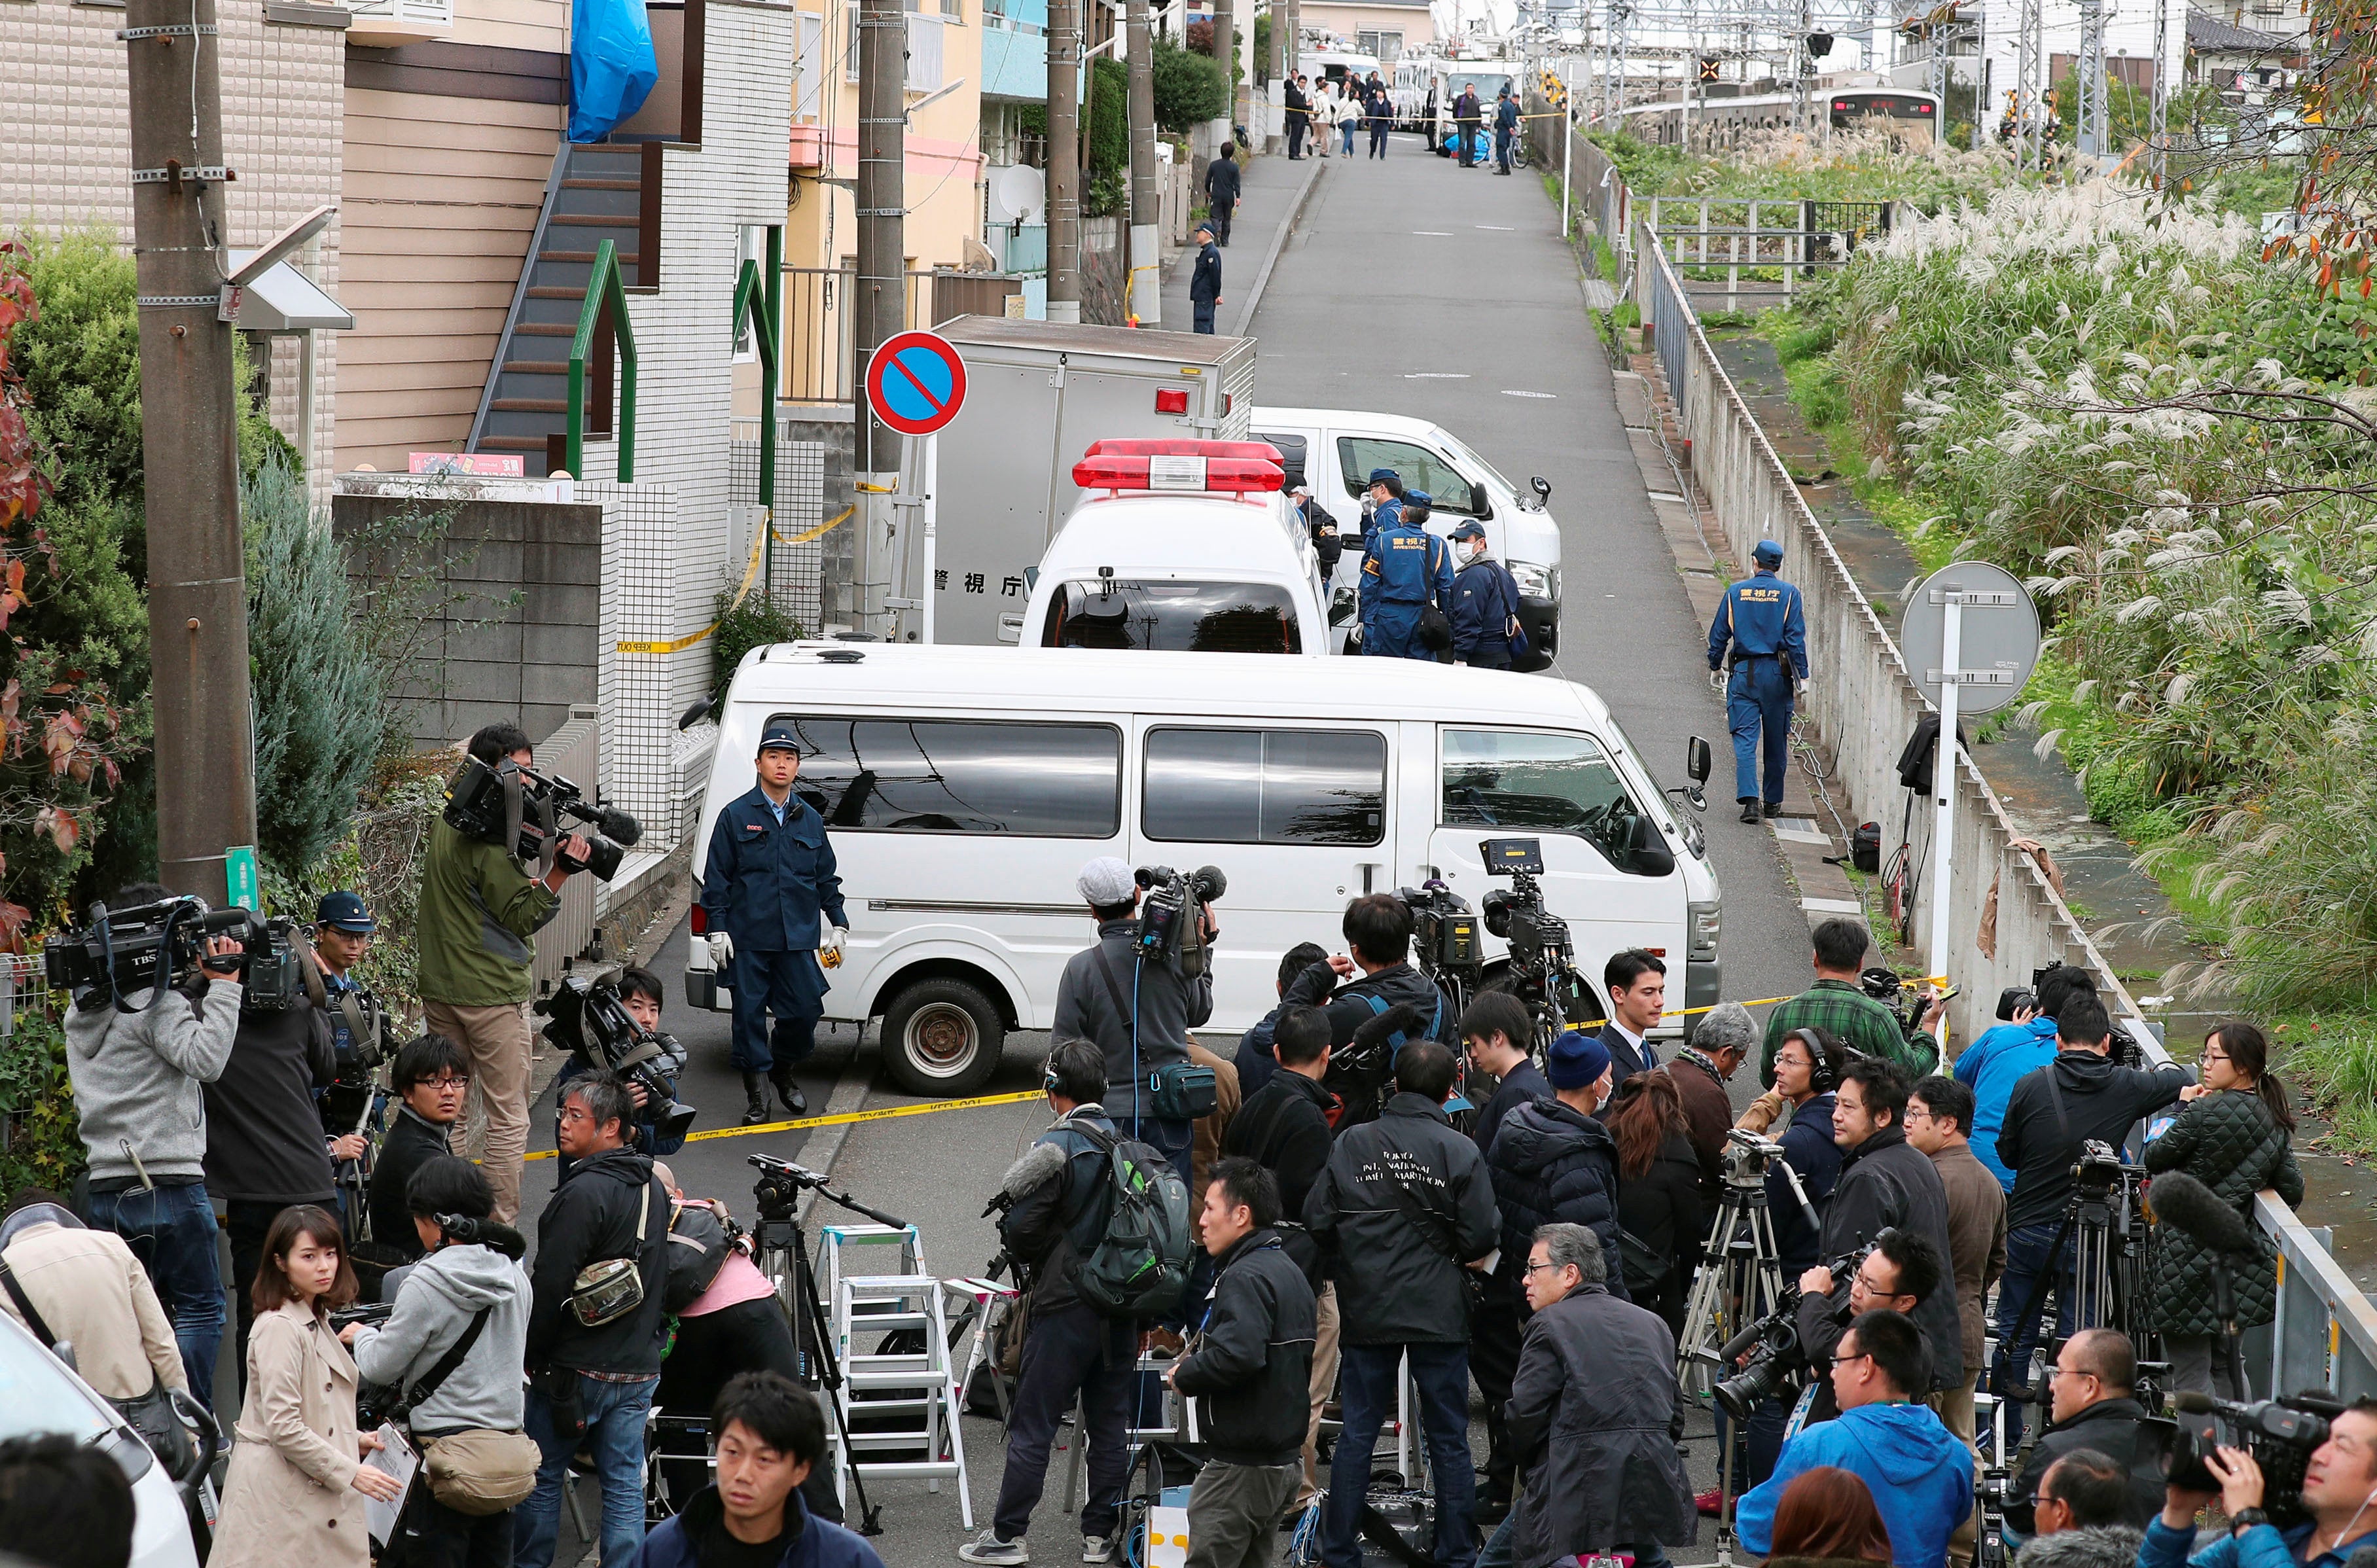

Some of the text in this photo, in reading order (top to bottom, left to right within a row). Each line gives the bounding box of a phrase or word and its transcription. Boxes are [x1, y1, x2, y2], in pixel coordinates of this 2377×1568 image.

[1740, 588, 1780, 597] 警視庁
[132, 953, 157, 967] TBS
